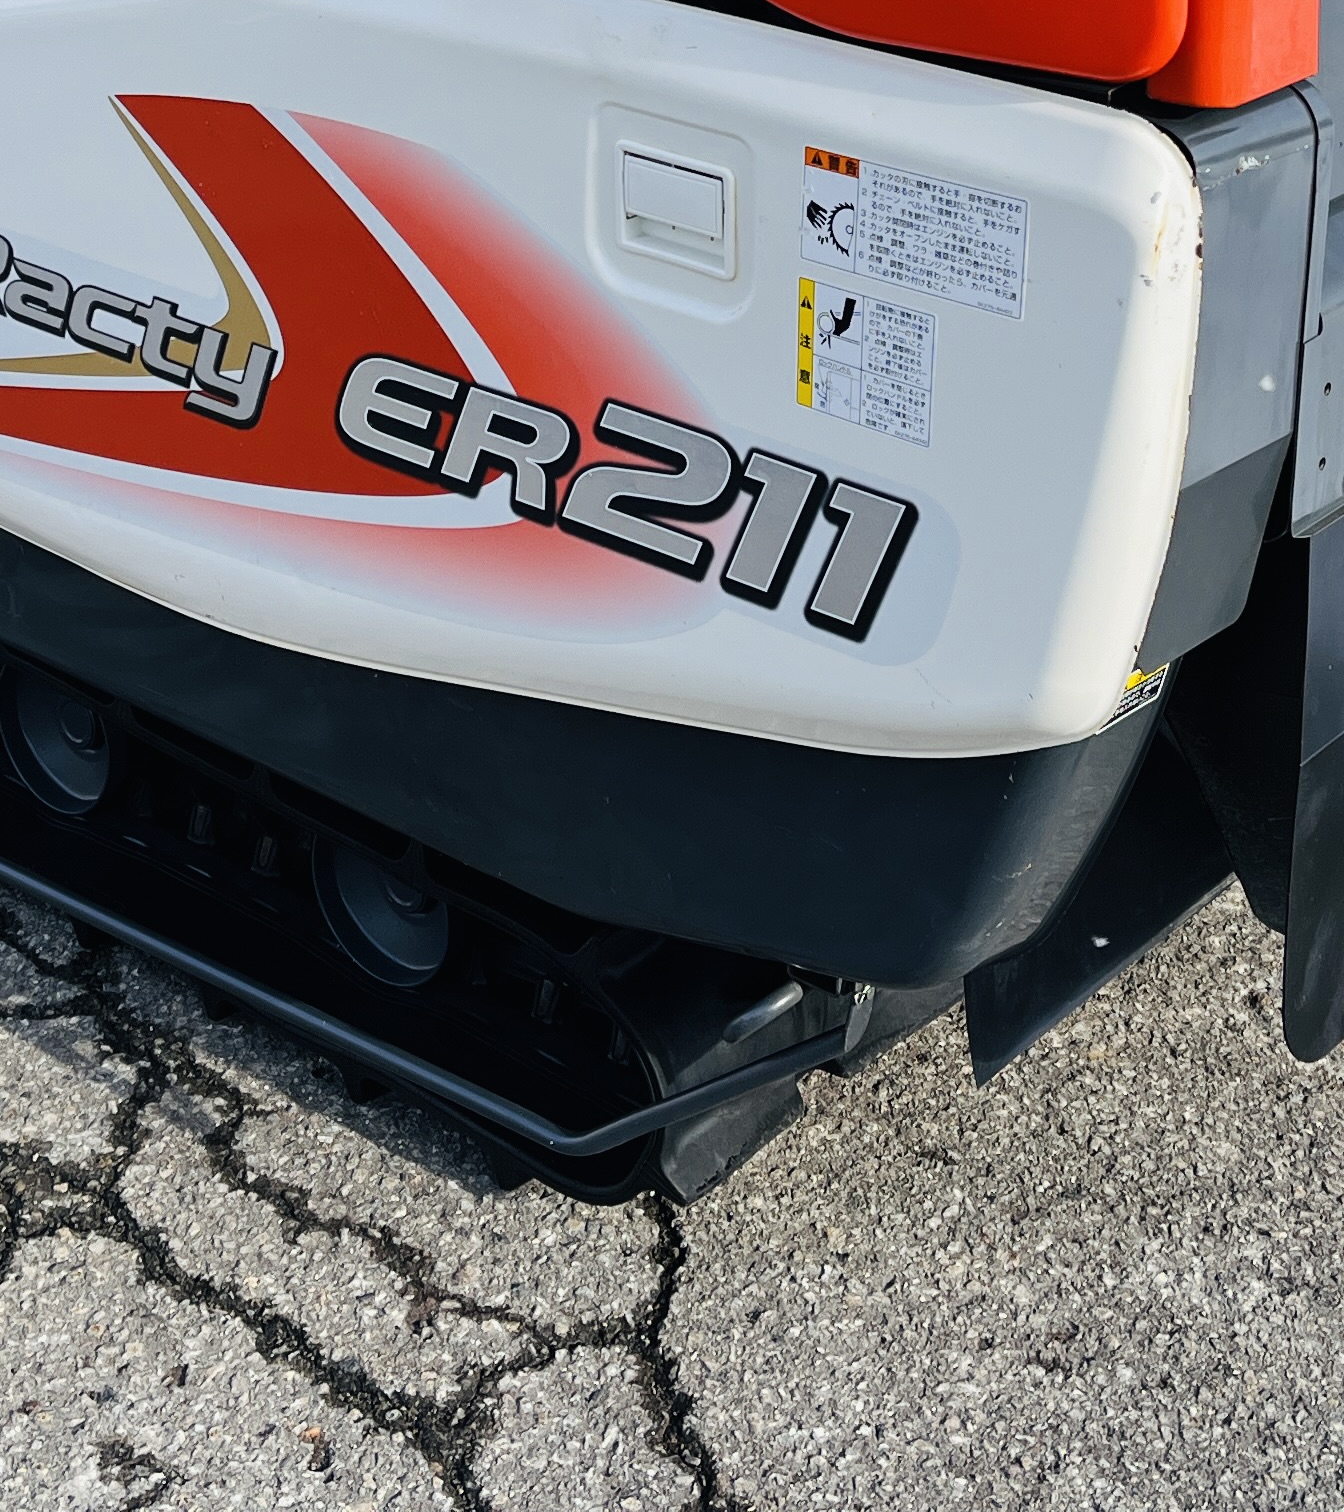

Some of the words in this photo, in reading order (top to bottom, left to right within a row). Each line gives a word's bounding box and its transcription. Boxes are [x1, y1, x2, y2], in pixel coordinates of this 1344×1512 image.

[828, 154, 857, 176] 警告
[799, 333, 812, 385] 注意
[334, 354, 919, 643] ER211
